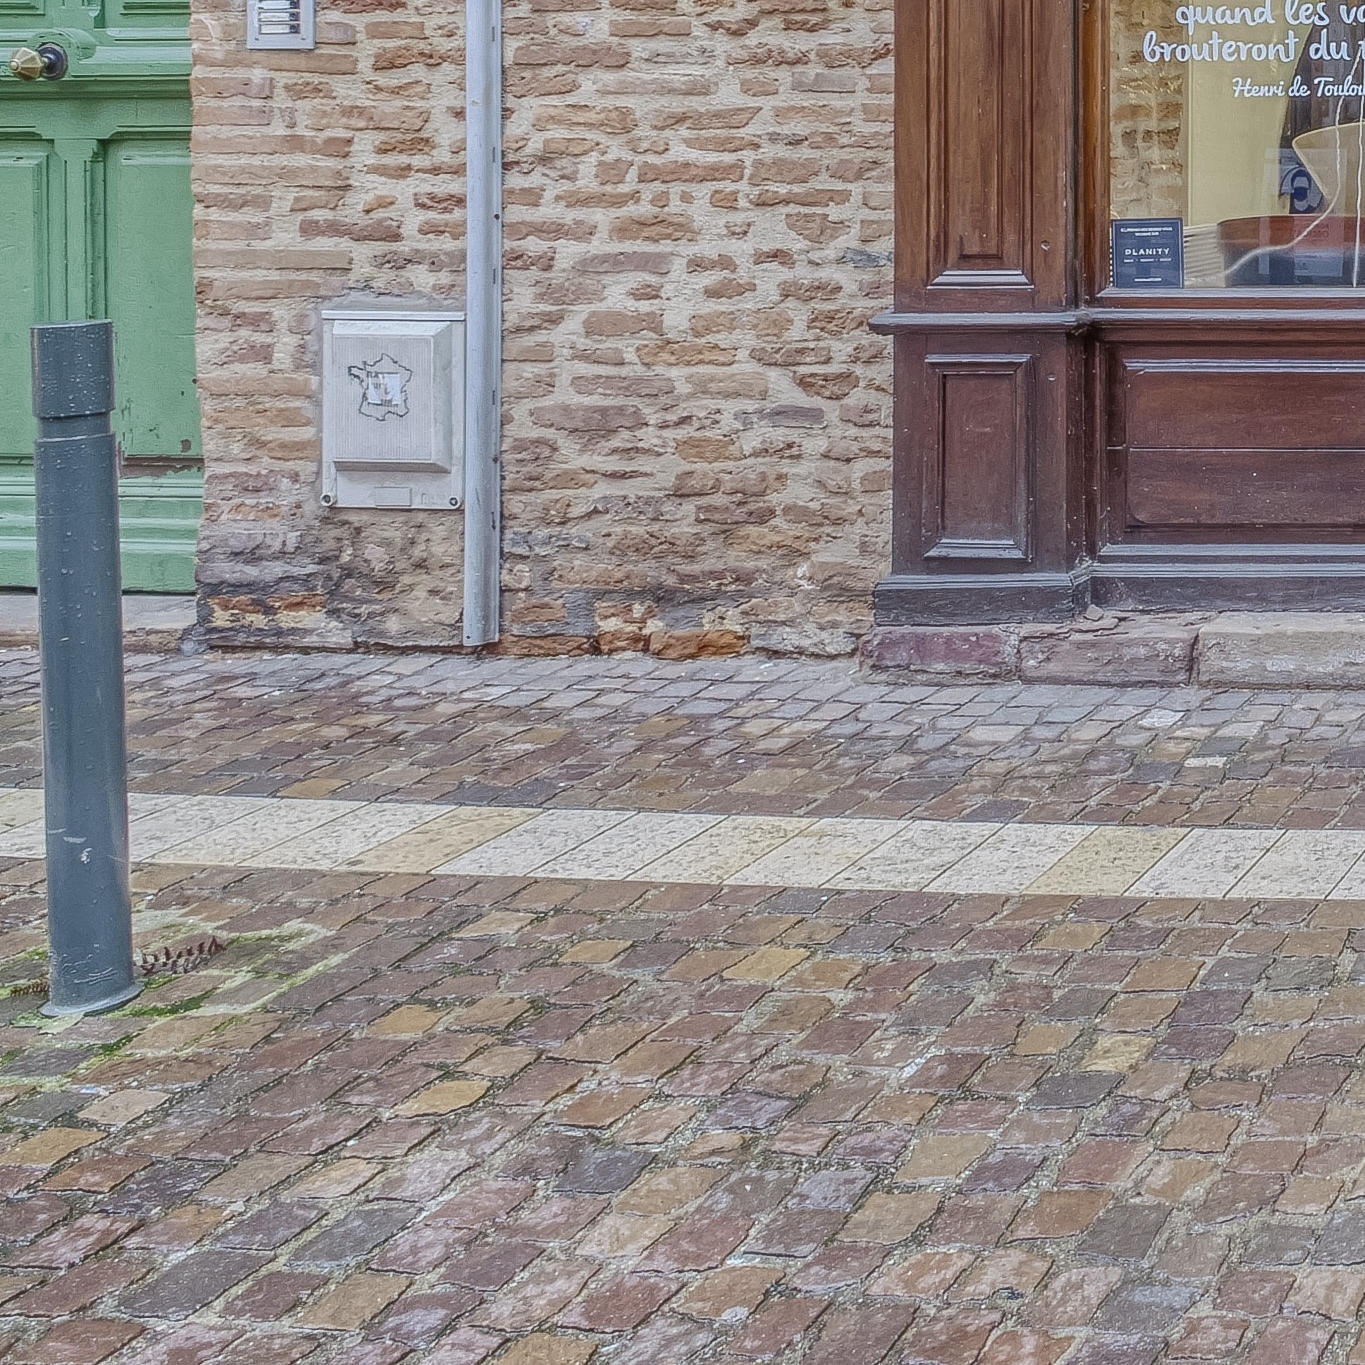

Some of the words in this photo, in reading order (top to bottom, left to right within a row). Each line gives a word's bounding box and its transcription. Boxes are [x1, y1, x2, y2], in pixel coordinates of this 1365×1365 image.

[1143, 30, 1300, 63] brouteront
[1309, 28, 1351, 62] du
[1232, 76, 1285, 98] Henri
[1289, 77, 1311, 97] de
[1124, 247, 1170, 256] PLANITY
